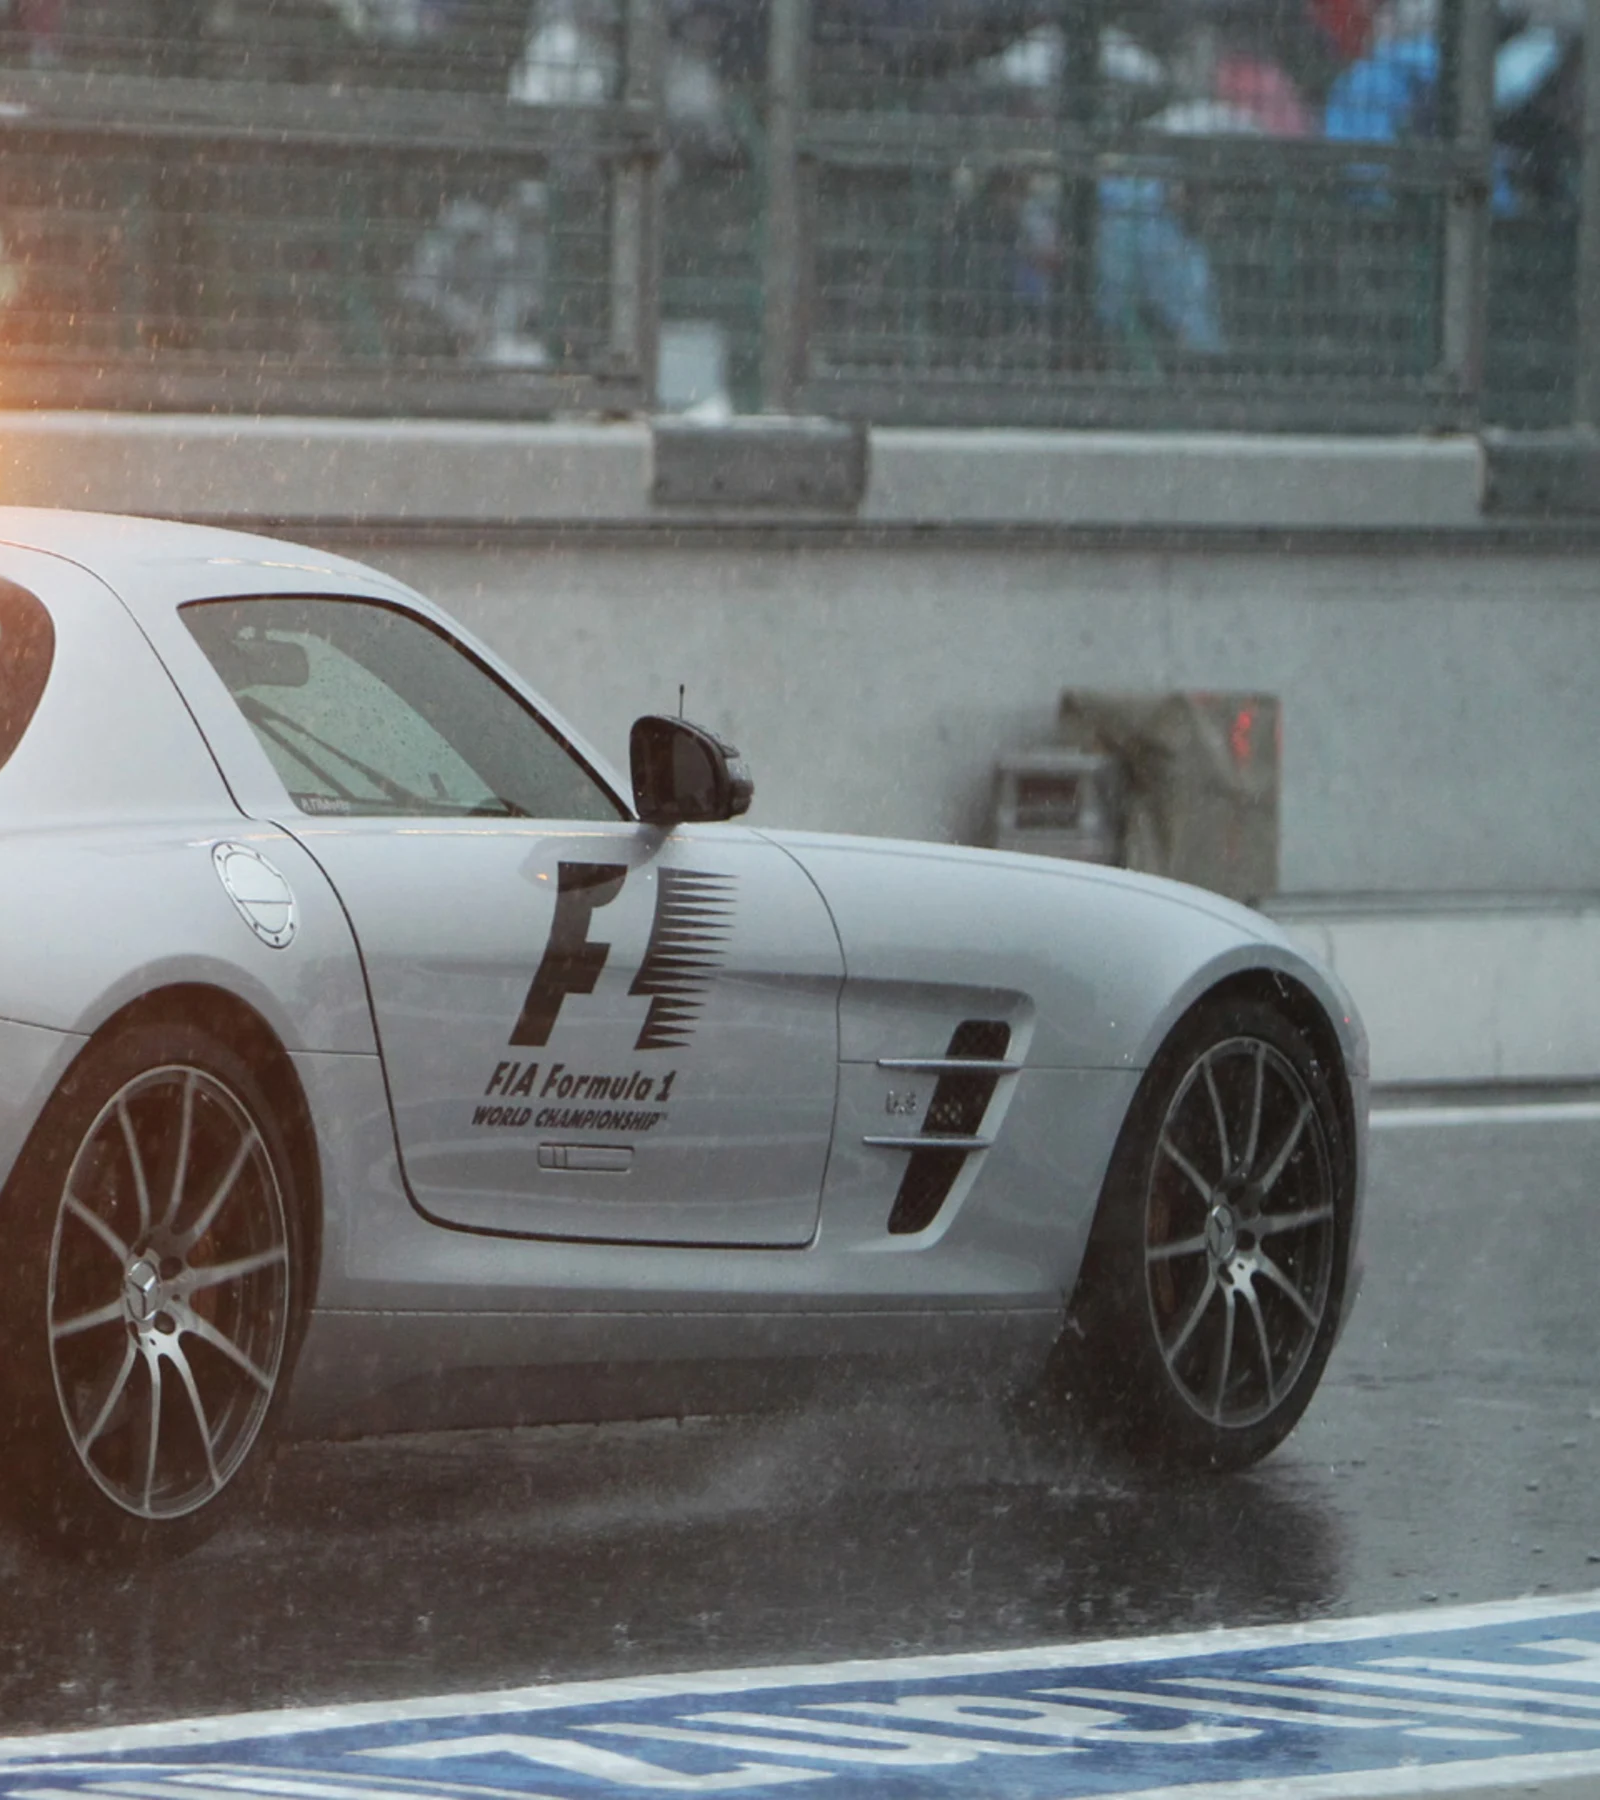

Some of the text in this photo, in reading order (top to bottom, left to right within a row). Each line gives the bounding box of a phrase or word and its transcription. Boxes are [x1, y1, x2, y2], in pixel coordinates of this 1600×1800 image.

[484, 1061, 678, 1103] FIA Formula 1
[471, 1105, 533, 1128] WORLD
